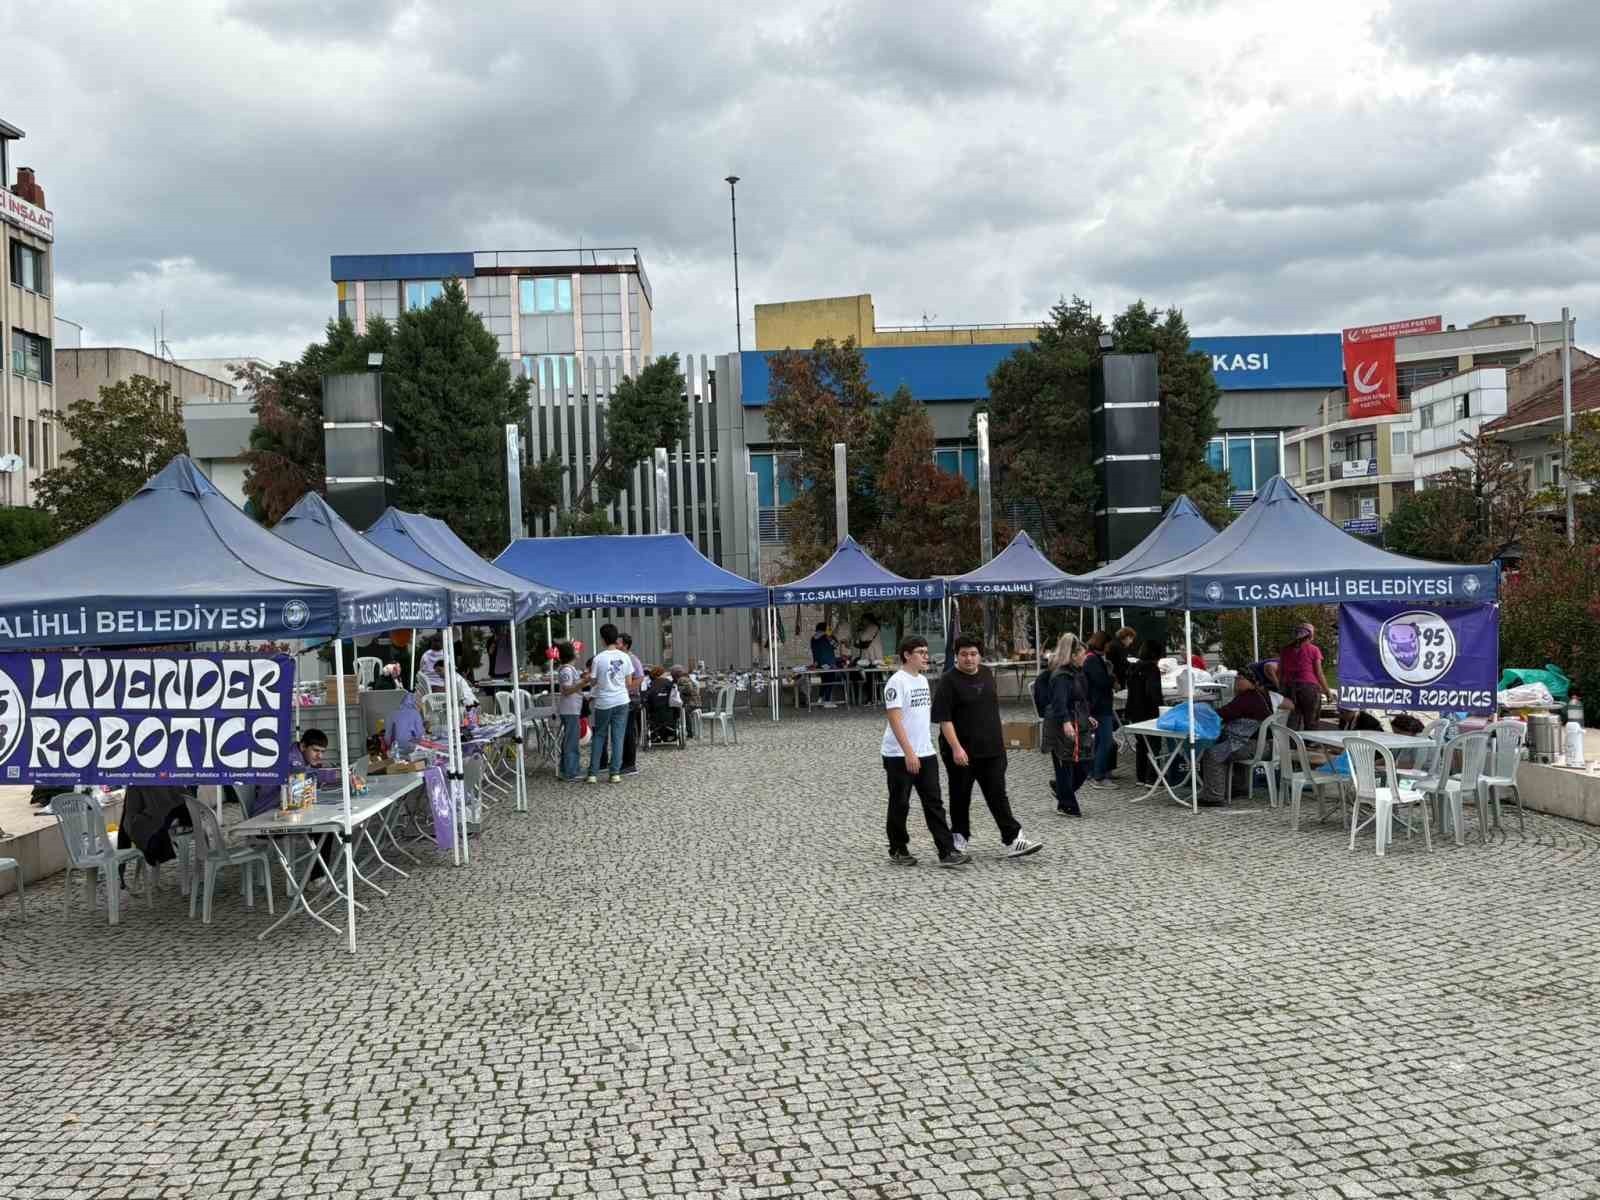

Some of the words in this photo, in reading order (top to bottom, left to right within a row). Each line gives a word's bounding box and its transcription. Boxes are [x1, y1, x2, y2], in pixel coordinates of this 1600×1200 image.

[1205, 352, 1269, 372] KASI
[799, 587, 857, 602] T.C.SALİHLİ
[859, 584, 920, 598] BELEDİYESİ
[976, 582, 1033, 593] T.C.SALİHLİ
[1234, 576, 1340, 601] T.C.SALİHLİ
[1345, 576, 1453, 595] BELEDİYESİ
[595, 593, 657, 605] BELEDİYESİ
[96, 602, 267, 633] BELEDİYESİ
[400, 599, 435, 620] BELEDİYESİ
[1423, 628, 1444, 646] 95
[1423, 651, 1446, 669] 83
[30, 658, 280, 710] LAVENDER
[1340, 686, 1412, 705] LAVENDER
[1419, 690, 1492, 706] ROBOTICS
[29, 716, 280, 769] ROBOTICS
